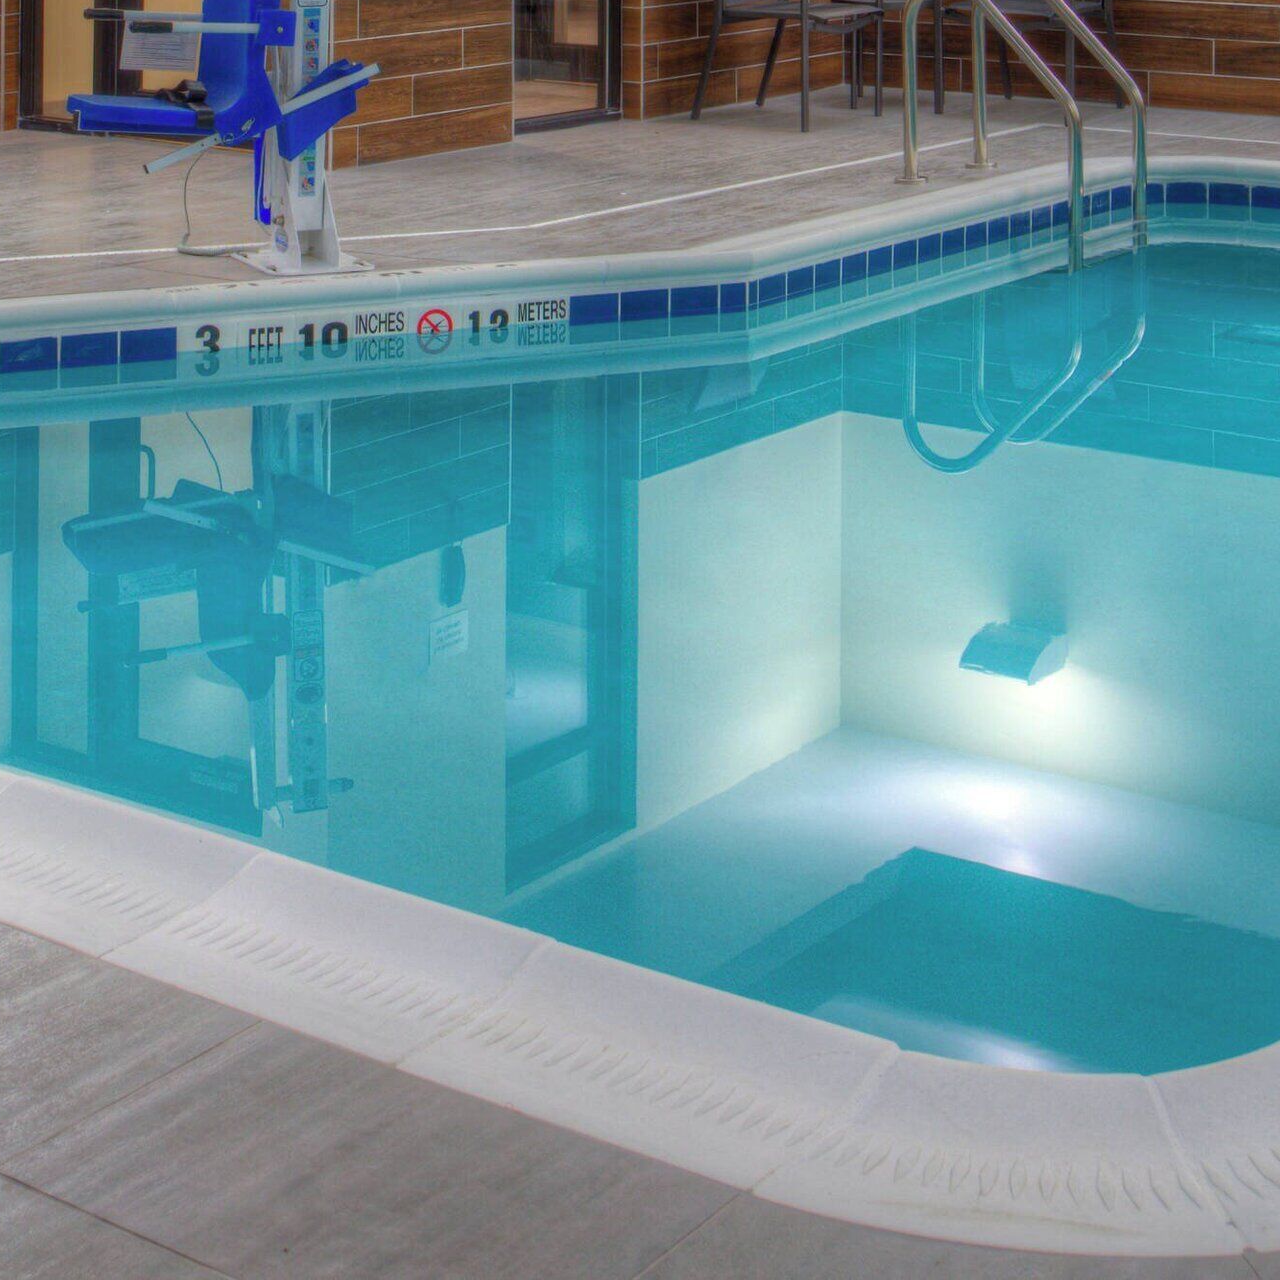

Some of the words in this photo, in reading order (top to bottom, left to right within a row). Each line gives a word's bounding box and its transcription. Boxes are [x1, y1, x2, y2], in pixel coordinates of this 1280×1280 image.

[195, 324, 221, 353] 3
[355, 311, 405, 335] INCHES
[517, 299, 567, 323] METERS
